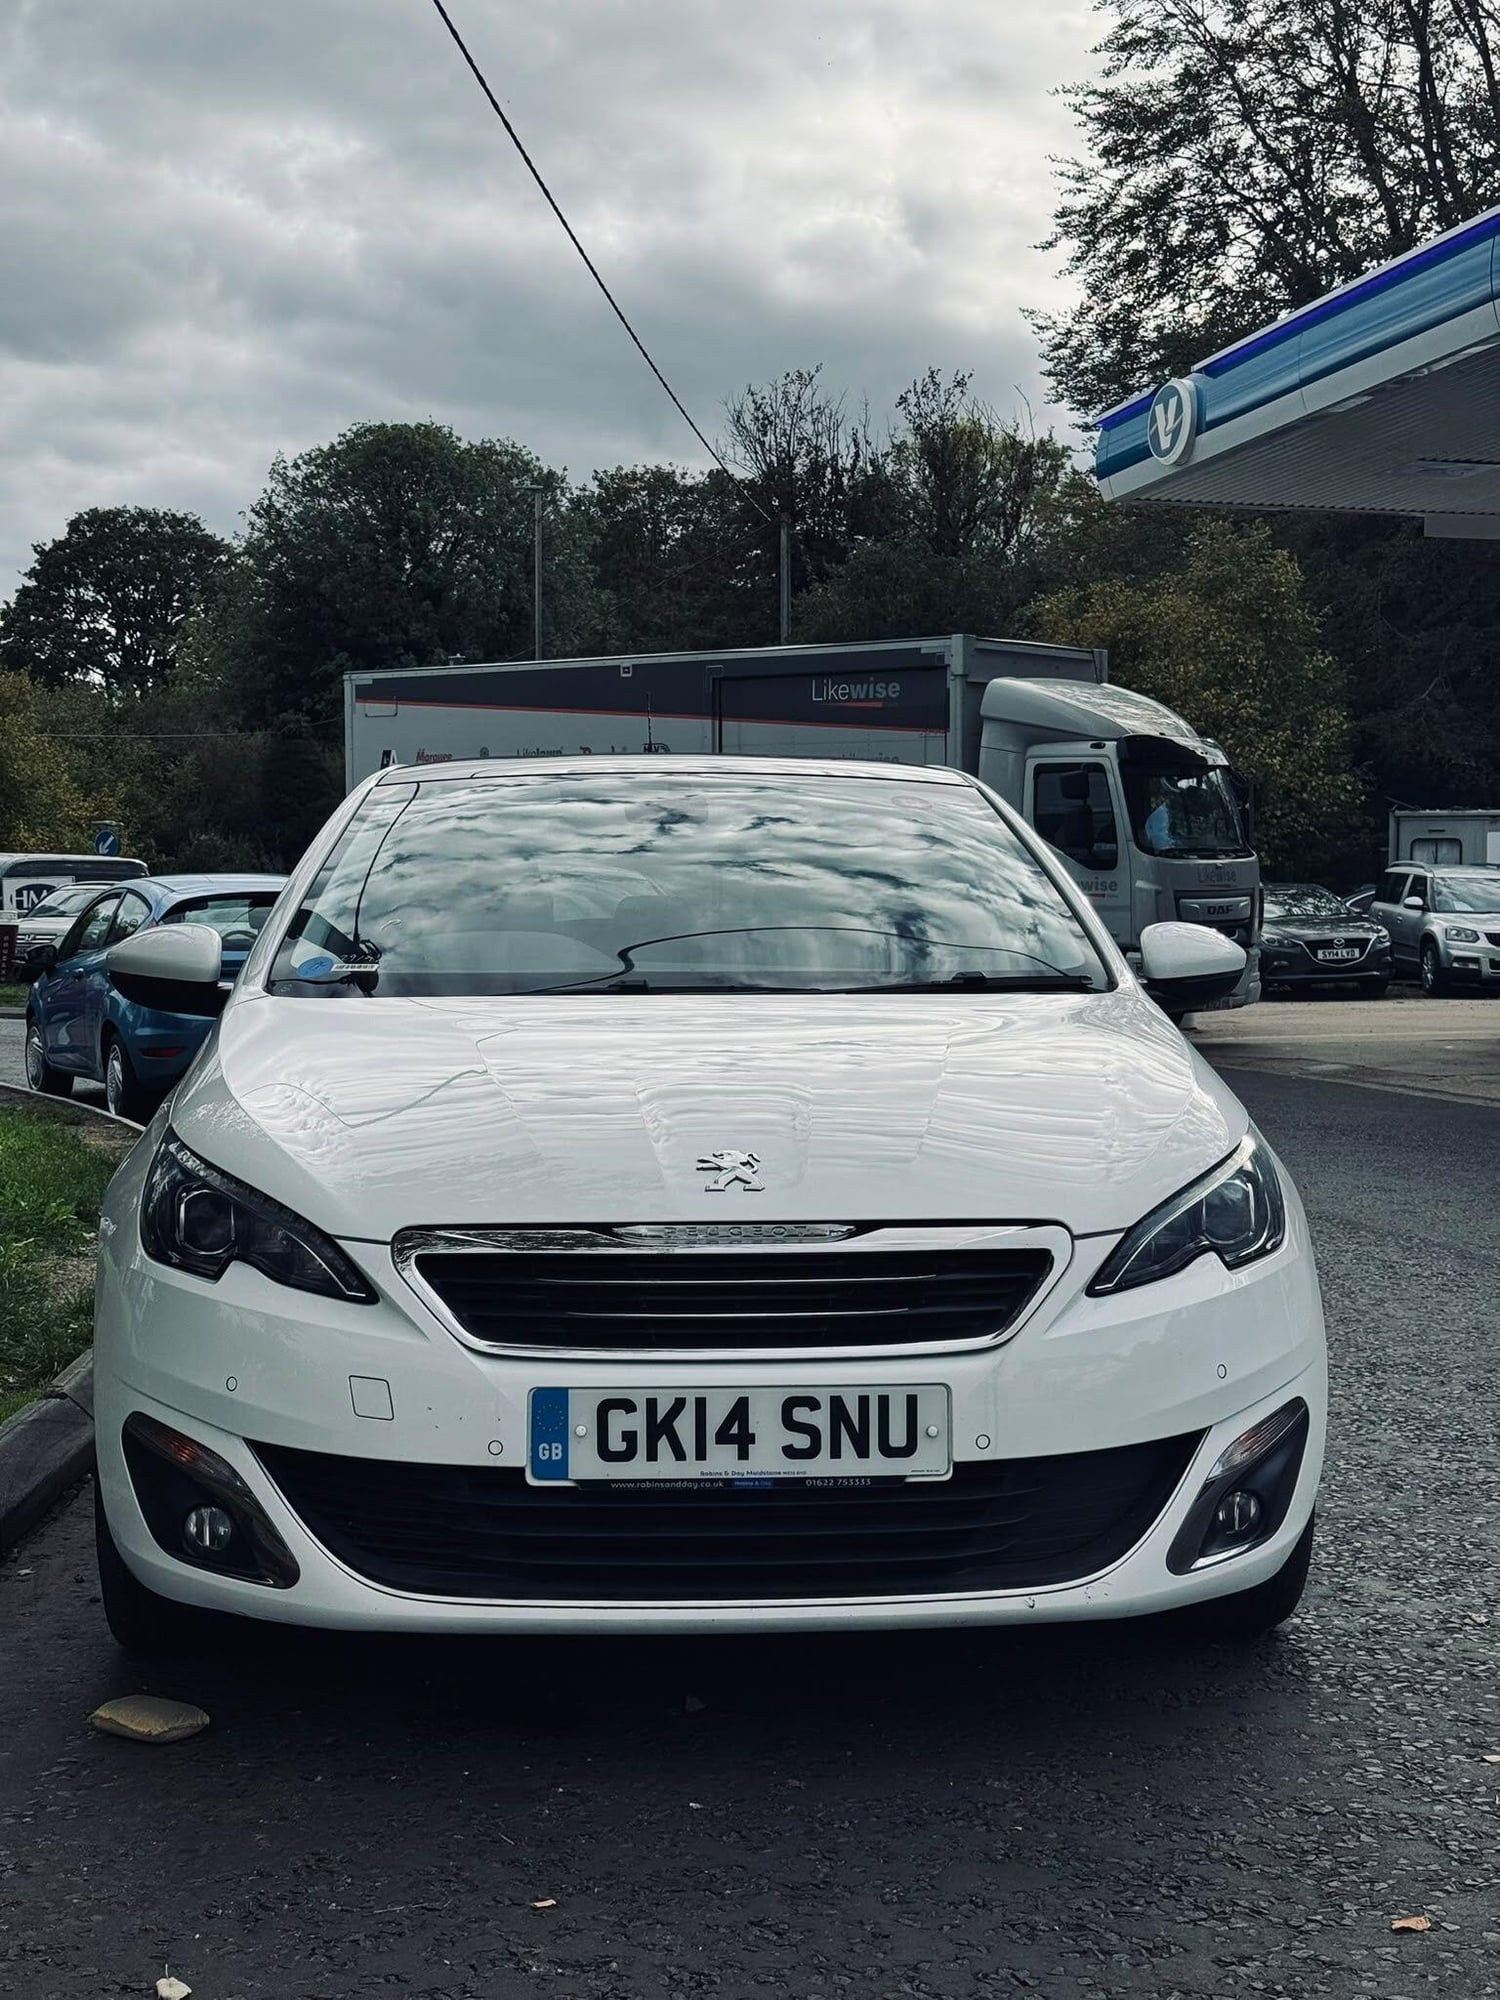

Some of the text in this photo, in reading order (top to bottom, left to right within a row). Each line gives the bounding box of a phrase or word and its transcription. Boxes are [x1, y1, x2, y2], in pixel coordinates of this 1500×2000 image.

[812, 676, 901, 701] Likewise
[1198, 866, 1238, 883] Likewise
[1207, 904, 1233, 915] DAF
[1322, 950, 1338, 958] SY14
[663, 1226, 807, 1237] PEUGEOT
[596, 1394, 918, 1462] GK14 SNU
[538, 1443, 562, 1460] GB
[611, 1479, 724, 1490] www.robinsandday.co.uk
[806, 1479, 871, 1487] 01622 753333
